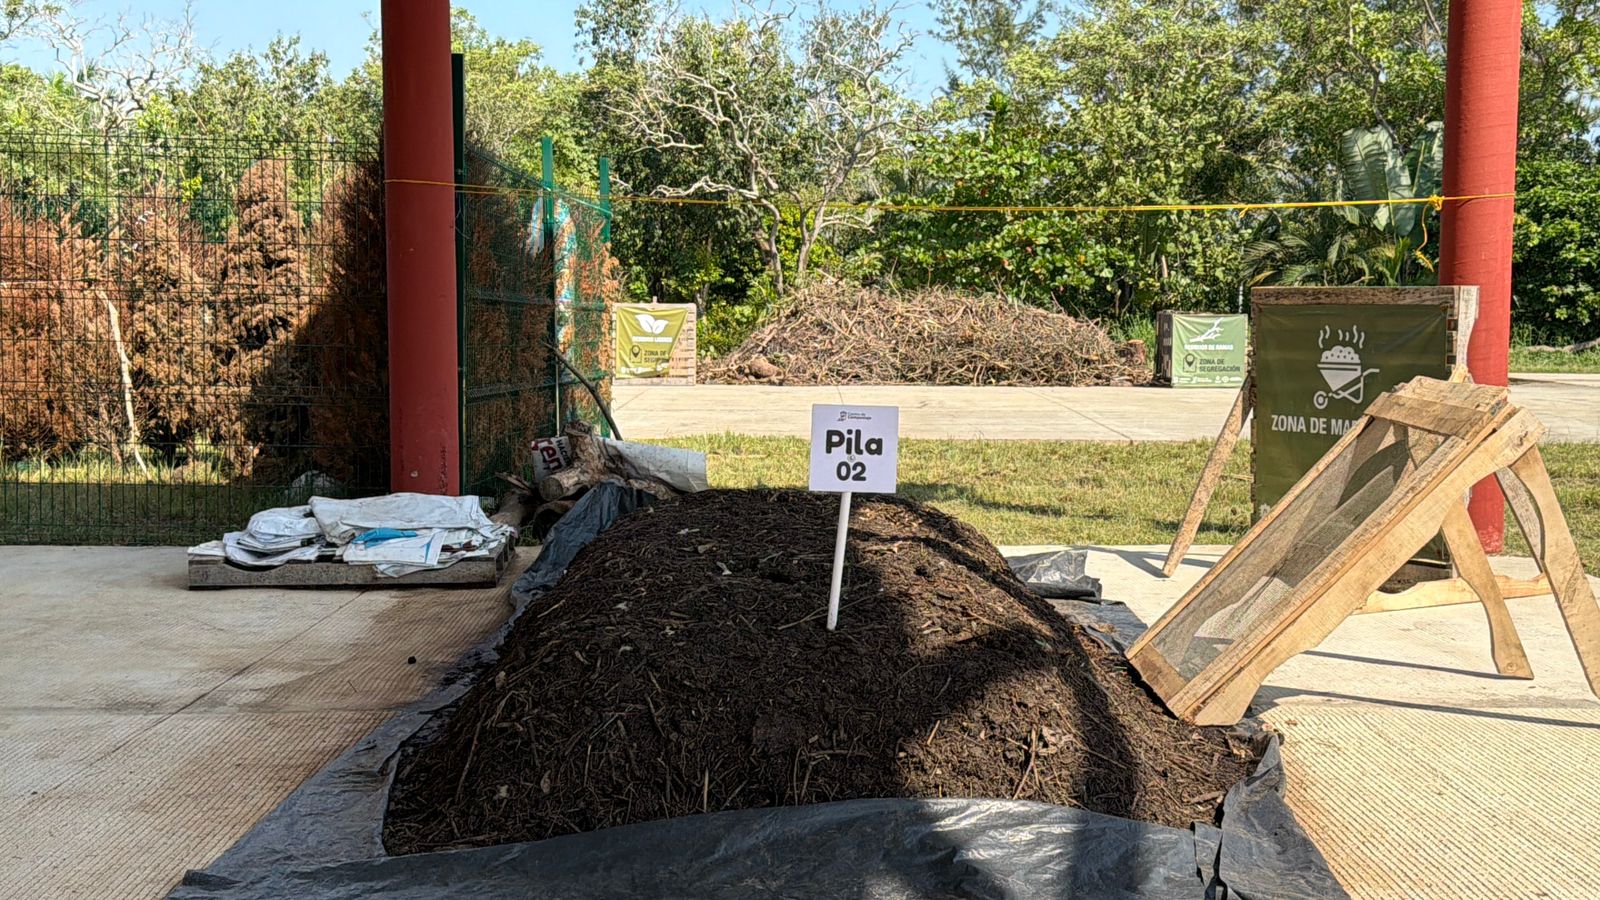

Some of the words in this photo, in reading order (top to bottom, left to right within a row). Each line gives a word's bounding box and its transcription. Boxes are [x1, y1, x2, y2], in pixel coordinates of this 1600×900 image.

[1271, 414, 1307, 433] ZONA
[1310, 417, 1328, 435] DE
[825, 429, 883, 456] Pila
[836, 461, 867, 481] 02
